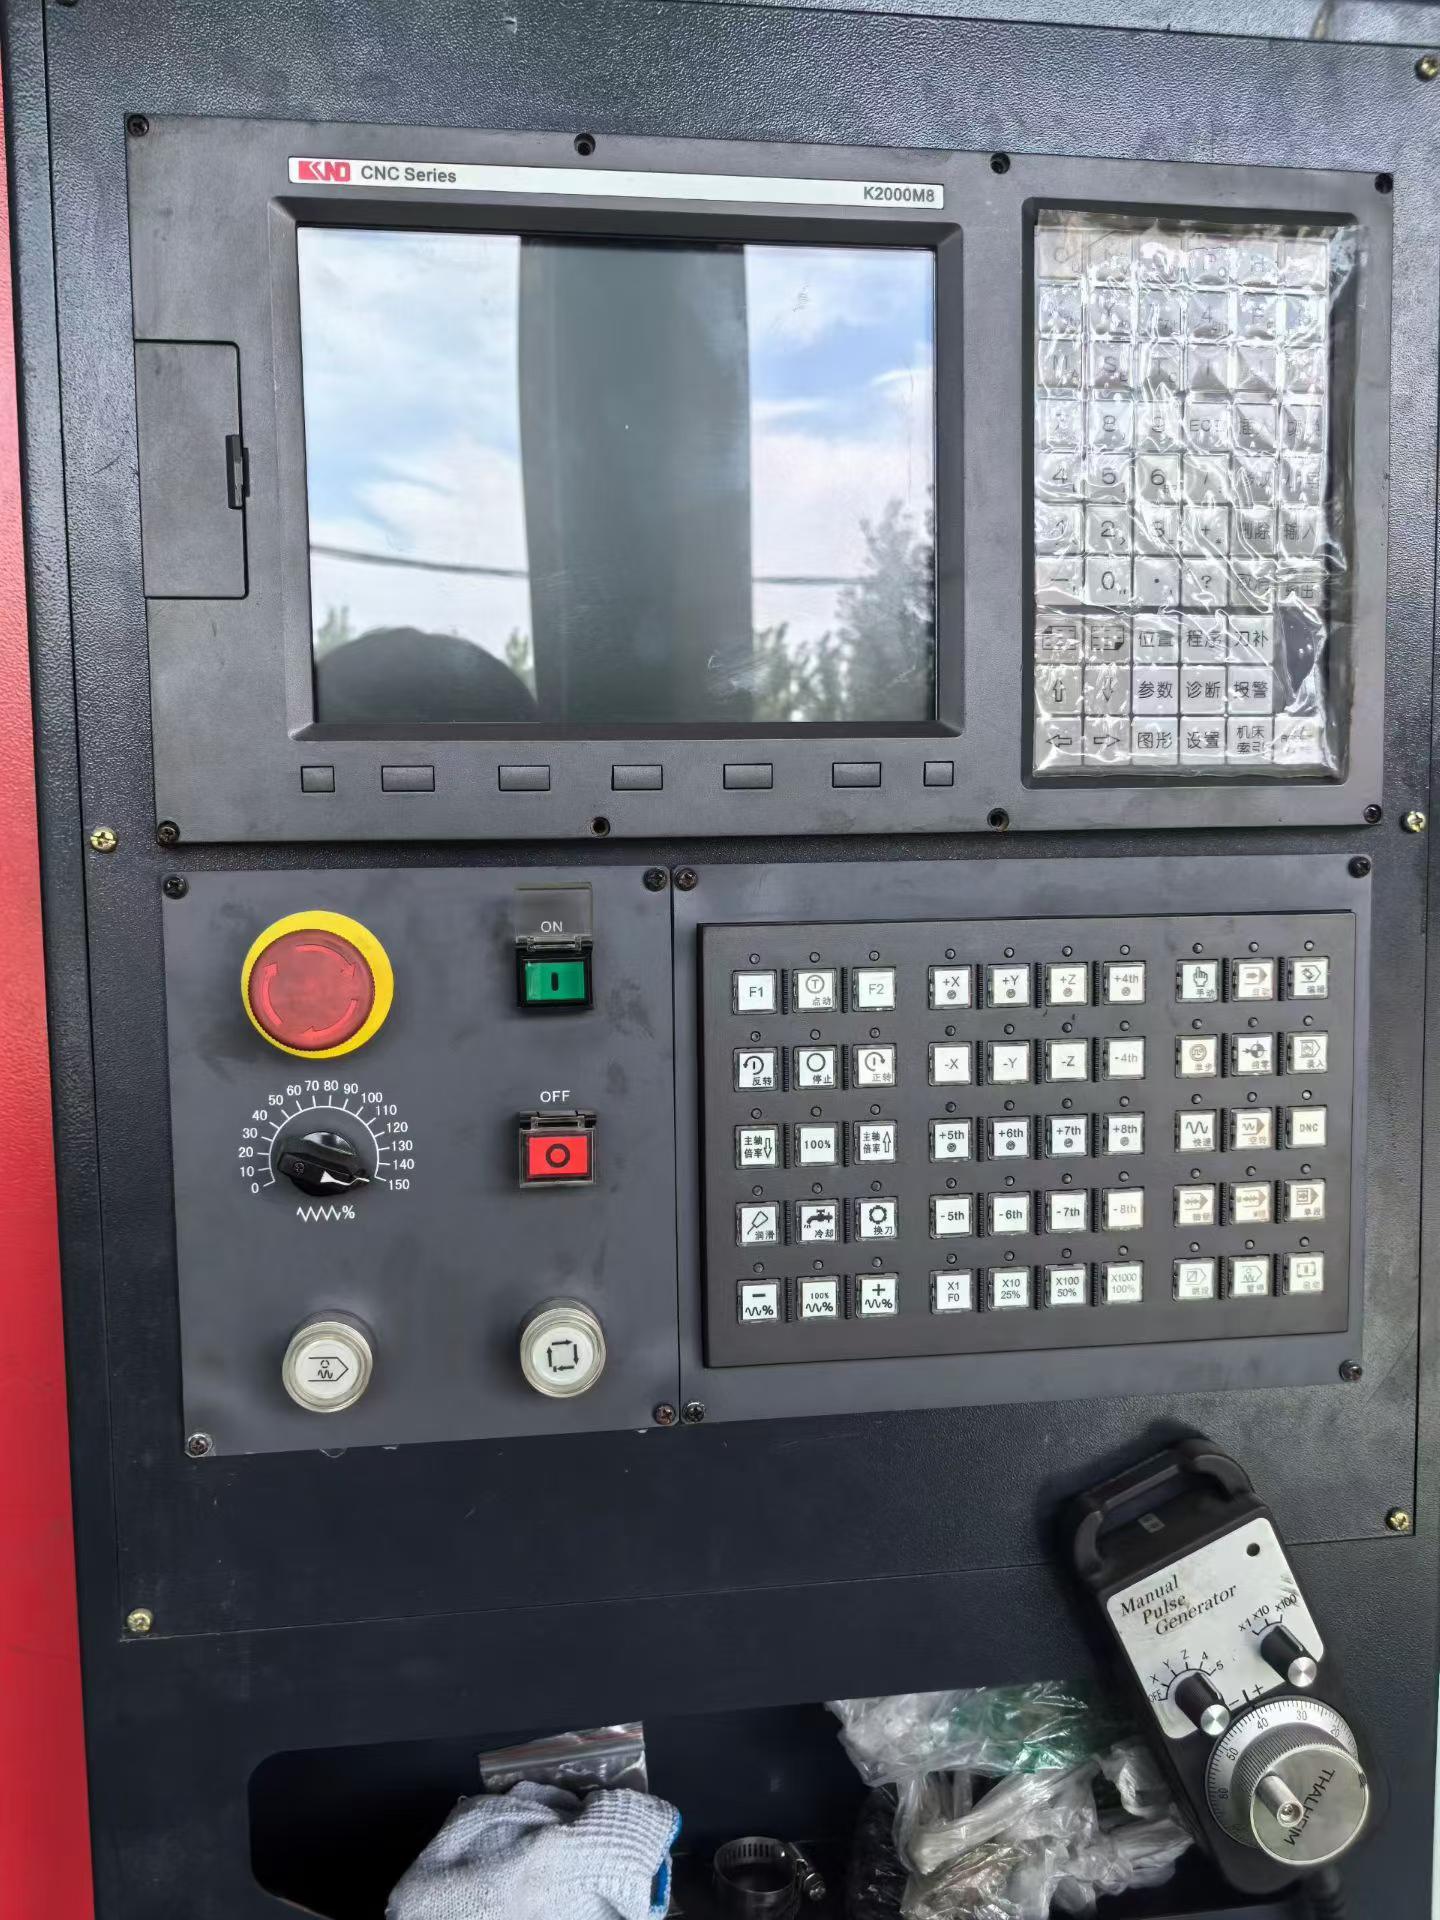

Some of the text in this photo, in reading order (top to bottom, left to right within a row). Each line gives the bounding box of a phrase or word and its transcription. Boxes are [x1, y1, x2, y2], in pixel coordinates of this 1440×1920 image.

[298, 160, 351, 182] KND
[361, 166, 457, 183] CNC Series
[864, 186, 935, 202] K2000M8
[1103, 415, 1116, 432] 8
[1052, 468, 1068, 484] 4
[1102, 468, 1117, 485] 5
[1151, 469, 1166, 486] 6
[1101, 521, 1116, 538] 2
[1101, 571, 1115, 590] 0
[1138, 630, 1173, 648] 位置
[1187, 630, 1222, 648] 程序
[1234, 630, 1269, 648] 刀补
[1138, 681, 1173, 699] 参数
[1186, 681, 1221, 699] 诊断
[1234, 681, 1269, 699] 报警
[1236, 726, 1265, 739] 机床
[1137, 731, 1173, 750] 图形
[1187, 731, 1220, 750] 设置
[540, 921, 564, 933] ON
[942, 976, 960, 987] +X
[1002, 975, 1019, 986] +Y
[1060, 974, 1077, 985] +Z
[1114, 974, 1139, 984] +4th
[750, 986, 764, 998] F1
[868, 984, 885, 995] F2
[752, 1076, 772, 1087] 反转
[812, 1075, 833, 1084] 停止
[872, 1072, 892, 1082] 正转
[286, 1085, 302, 1096] 60
[305, 1080, 320, 1091] 70
[324, 1080, 339, 1091] 80
[344, 1083, 359, 1094] 90
[268, 1095, 284, 1106] 50
[362, 1092, 383, 1103] 100
[540, 1091, 571, 1103] OFF
[252, 1110, 268, 1121] 40
[376, 1105, 398, 1116] 110
[387, 1122, 408, 1133] 120
[998, 1128, 1024, 1138] +6th
[1056, 1126, 1082, 1136] +7th
[1113, 1124, 1138, 1134] +8th
[1299, 1122, 1319, 1133] DNC
[242, 1128, 258, 1139] 30
[863, 1131, 881, 1142] 主轴
[939, 1130, 965, 1140] +5th
[392, 1140, 413, 1151] 130
[744, 1136, 763, 1146] 主轴
[804, 1140, 831, 1150] 100%
[238, 1147, 254, 1158] 20
[744, 1148, 763, 1159] 倍率
[863, 1144, 881, 1154] 倍率
[393, 1159, 415, 1170] 140
[240, 1166, 255, 1177] 10
[252, 1182, 259, 1194] 0
[389, 1180, 410, 1190] 150
[755, 1230, 775, 1241] 润滑
[814, 1229, 834, 1238] 冷却
[873, 1226, 893, 1236] 换刀
[1002, 1279, 1021, 1288] X10
[1056, 1276, 1080, 1286] X100
[1110, 1273, 1137, 1283] X1000
[948, 1282, 960, 1291] X1
[1112, 1284, 1136, 1294] 100%
[810, 1292, 830, 1300] 100%
[948, 1294, 960, 1302] F0
[1000, 1290, 1021, 1300] 25%
[1057, 1288, 1077, 1297] 50%
[1120, 1574, 1179, 1617] Manual
[1142, 1594, 1186, 1625] Pulse
[1155, 1584, 1237, 1635] Generator
[1180, 1649, 1189, 1660] Z
[1202, 1652, 1209, 1661] 4
[1162, 1659, 1171, 1669] Y
[1216, 1660, 1224, 1671] 5
[1150, 1673, 1159, 1684] X
[1149, 1688, 1162, 1703] OFF
[1296, 1710, 1308, 1721] 30
[1256, 1718, 1269, 1730] 40
[1330, 1724, 1340, 1738] 20
[1226, 1747, 1239, 1761] 50
